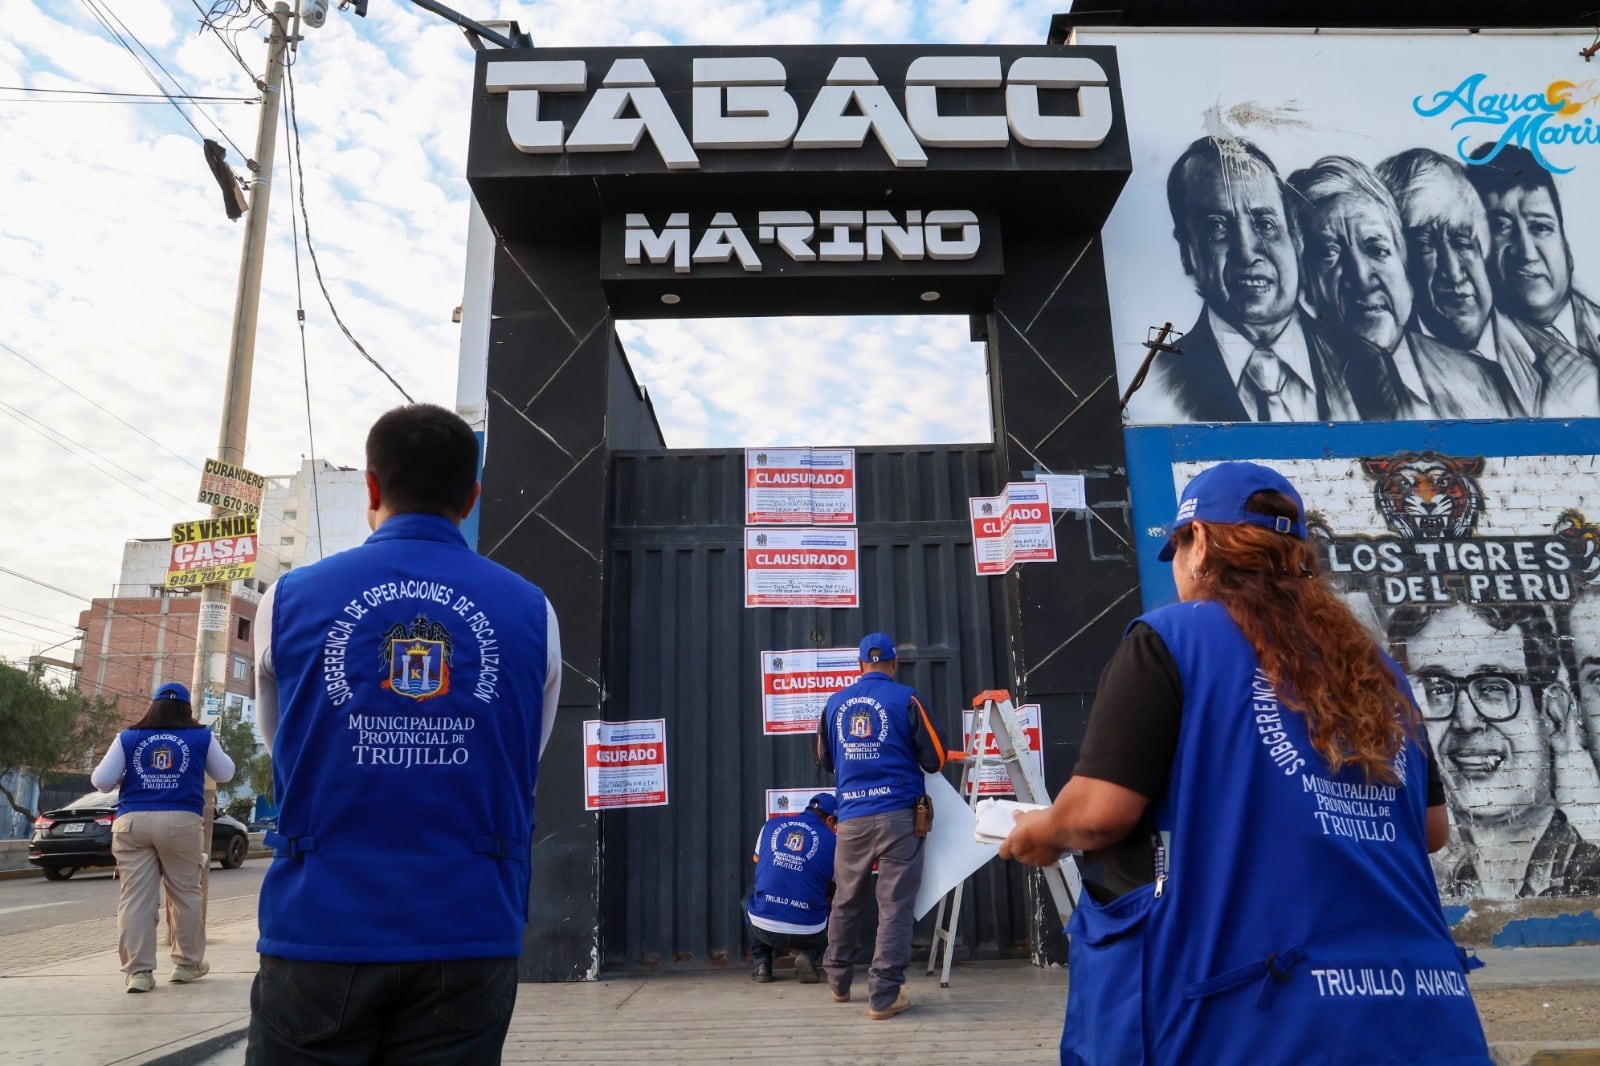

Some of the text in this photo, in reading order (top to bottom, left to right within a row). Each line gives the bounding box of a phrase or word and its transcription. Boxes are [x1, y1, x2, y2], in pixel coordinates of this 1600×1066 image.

[486, 56, 1113, 169] TABACO
[1412, 73, 1567, 131] Agua
[624, 209, 981, 273] MARINO
[205, 460, 264, 489] CURANDERO
[756, 473, 845, 485] CLAUSURADO
[200, 490, 220, 505] 978
[223, 495, 242, 511] 670
[173, 515, 257, 543] SE VENDE
[174, 536, 254, 564] CASA
[755, 554, 848, 565] CLAUSURADO
[1328, 541, 1571, 573] LOS TIGRES
[1384, 573, 1571, 603] DEL PERU
[324, 619, 356, 706] SUBGERENCIA
[344, 599, 369, 620] DE
[363, 580, 454, 607] OPERACIONES
[452, 595, 475, 616] DE
[411, 669, 421, 679] K
[349, 714, 475, 731] MUNICIPALIDAD
[359, 730, 464, 744] PROVINCIAL DE
[352, 745, 469, 769] TRUJILLO
[844, 752, 880, 760] TRUJILLO
[141, 782, 179, 790] TRUJILLO
[868, 786, 891, 796] AVANZA
[1302, 774, 1396, 802] MUNICIPALIDAD
[1315, 794, 1390, 817] PROVINCIAL DE
[1314, 811, 1396, 842] TRUJILLO
[765, 894, 810, 910] TRUJILLO AVANZA
[1311, 968, 1470, 997] TRUJILLO AVANZA
